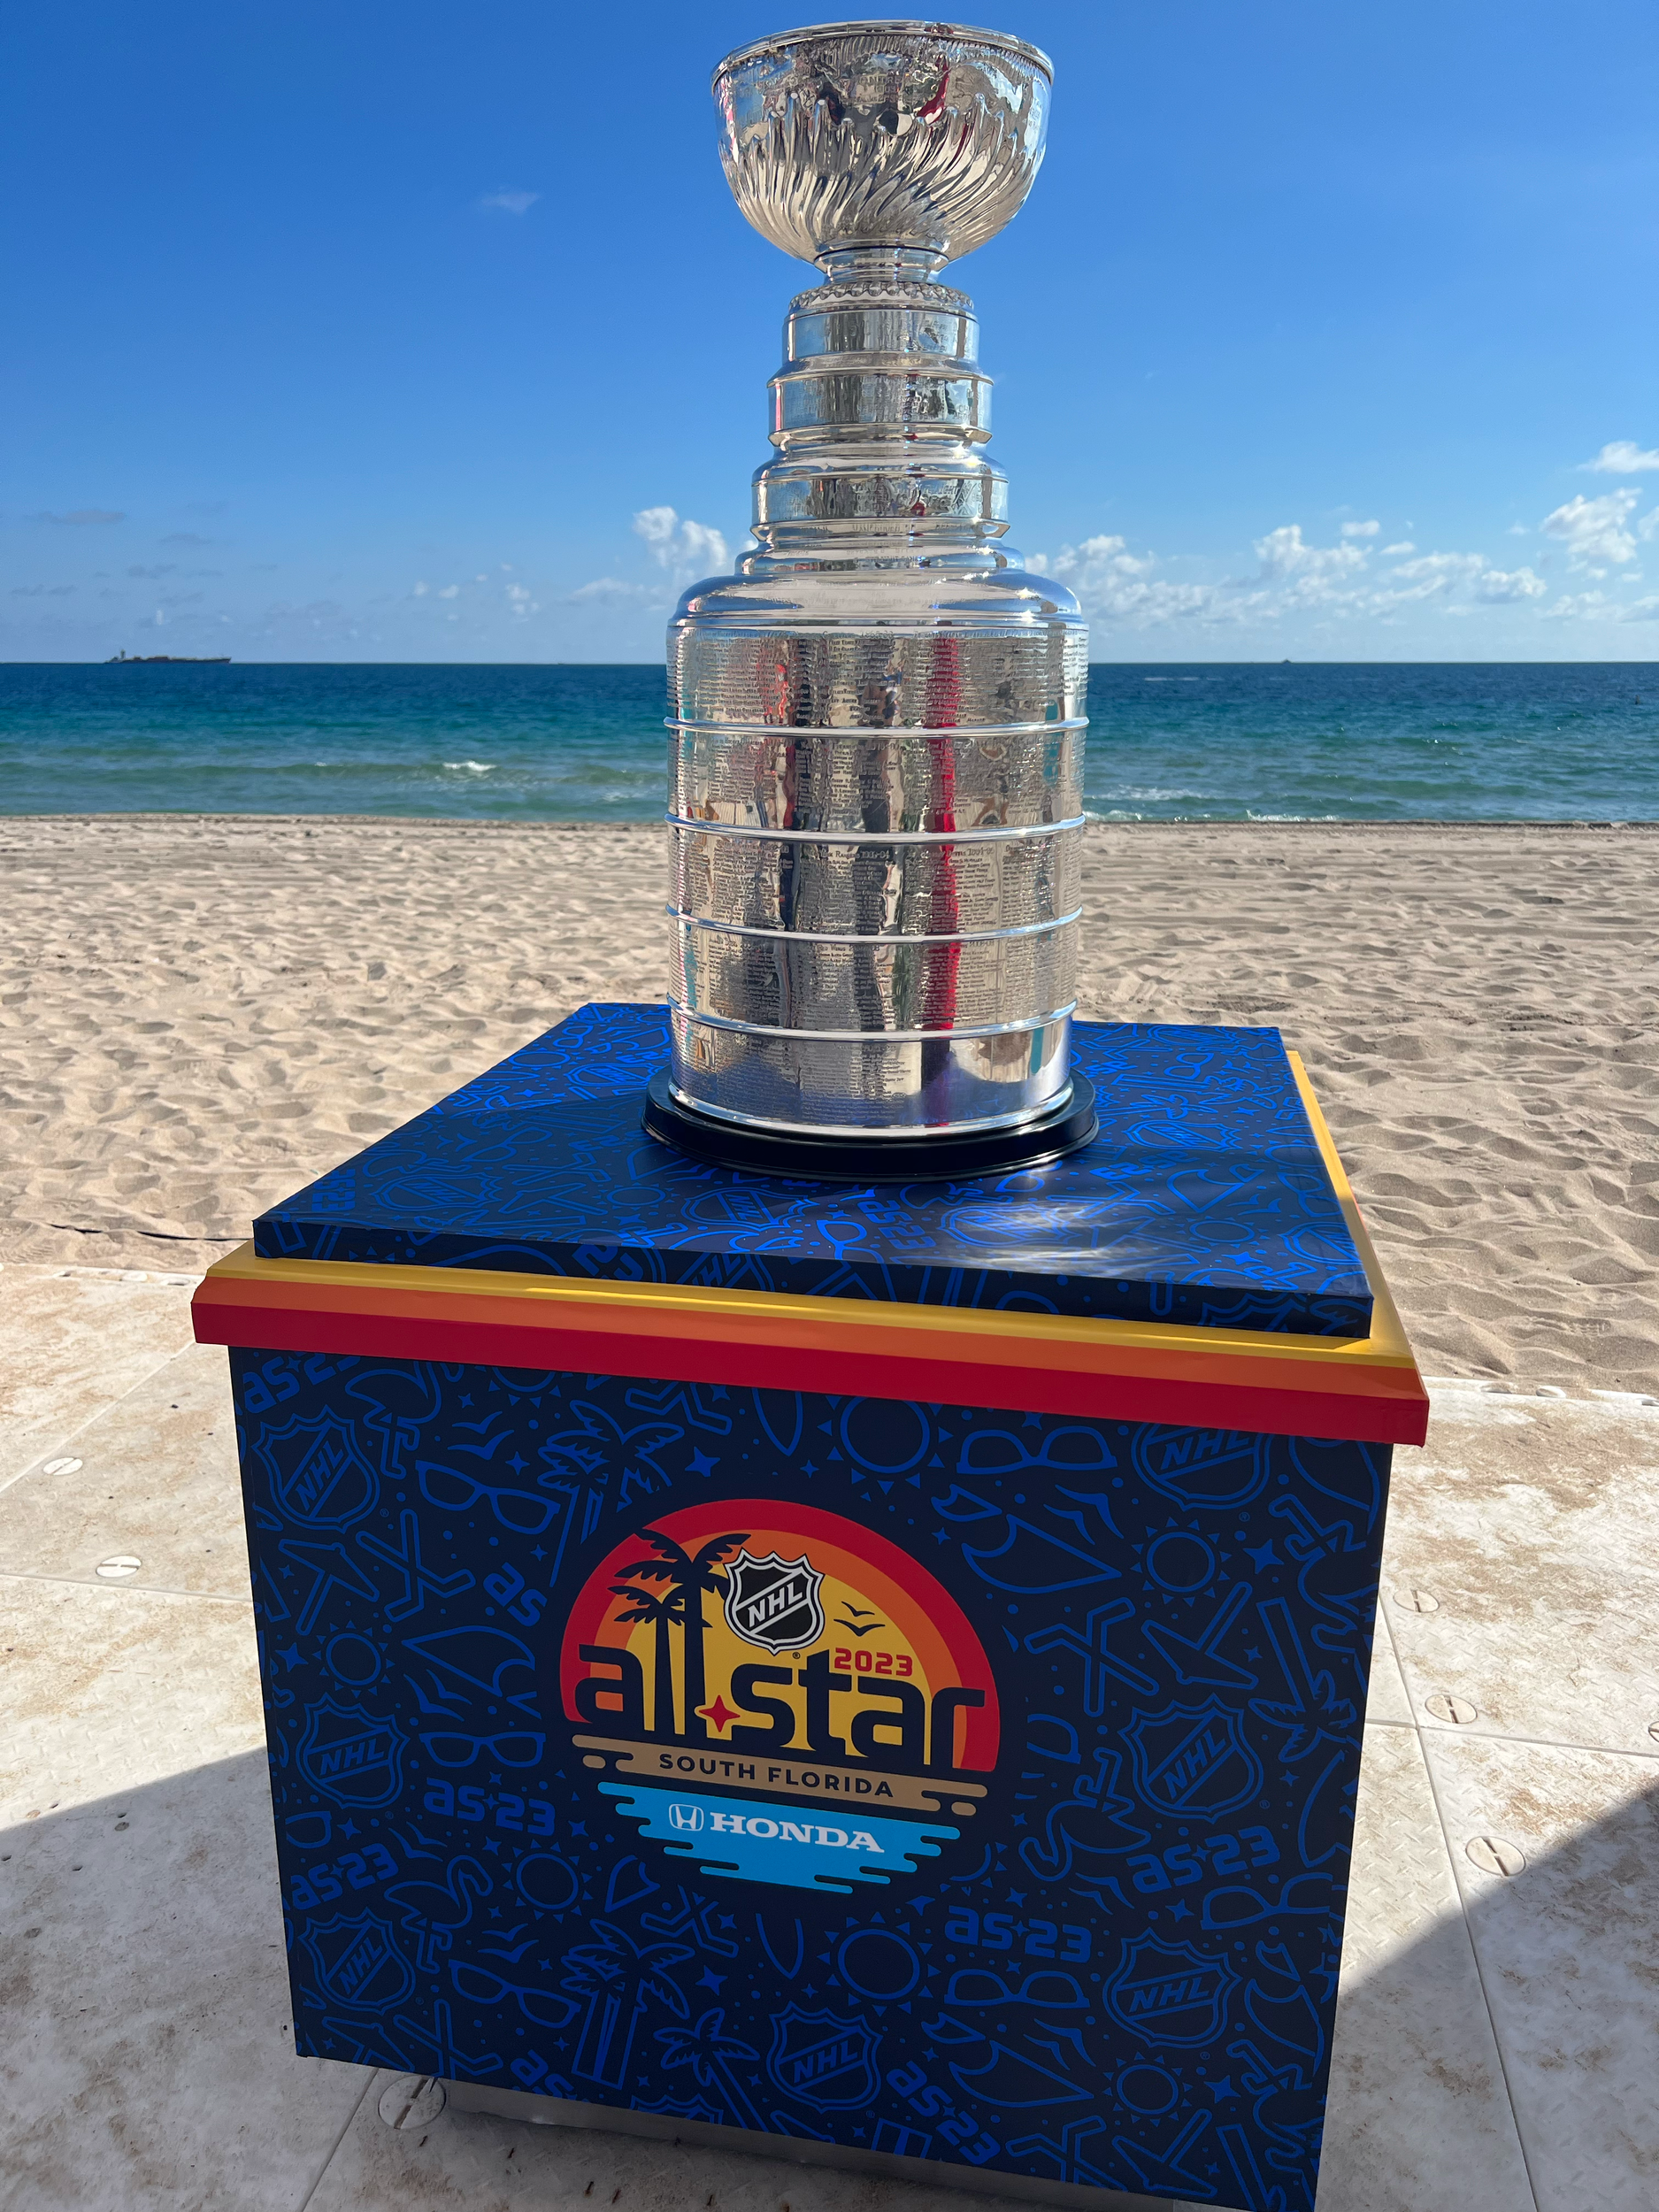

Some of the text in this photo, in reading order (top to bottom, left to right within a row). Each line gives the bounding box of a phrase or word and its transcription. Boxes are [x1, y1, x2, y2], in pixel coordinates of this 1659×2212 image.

[296, 1440, 343, 1512] NHL
[748, 1582, 804, 1628] NHL
[833, 1647, 913, 1678] 2023
[319, 1738, 384, 1776] NHL
[659, 1753, 894, 1798] SOUTH FLORIDA
[1163, 1729, 1226, 1799] NHL
[710, 1811, 885, 1854] HONDA
[338, 1936, 383, 1994] NHL
[1129, 1977, 1210, 2013] NHL
[794, 2040, 858, 2083] NHL
